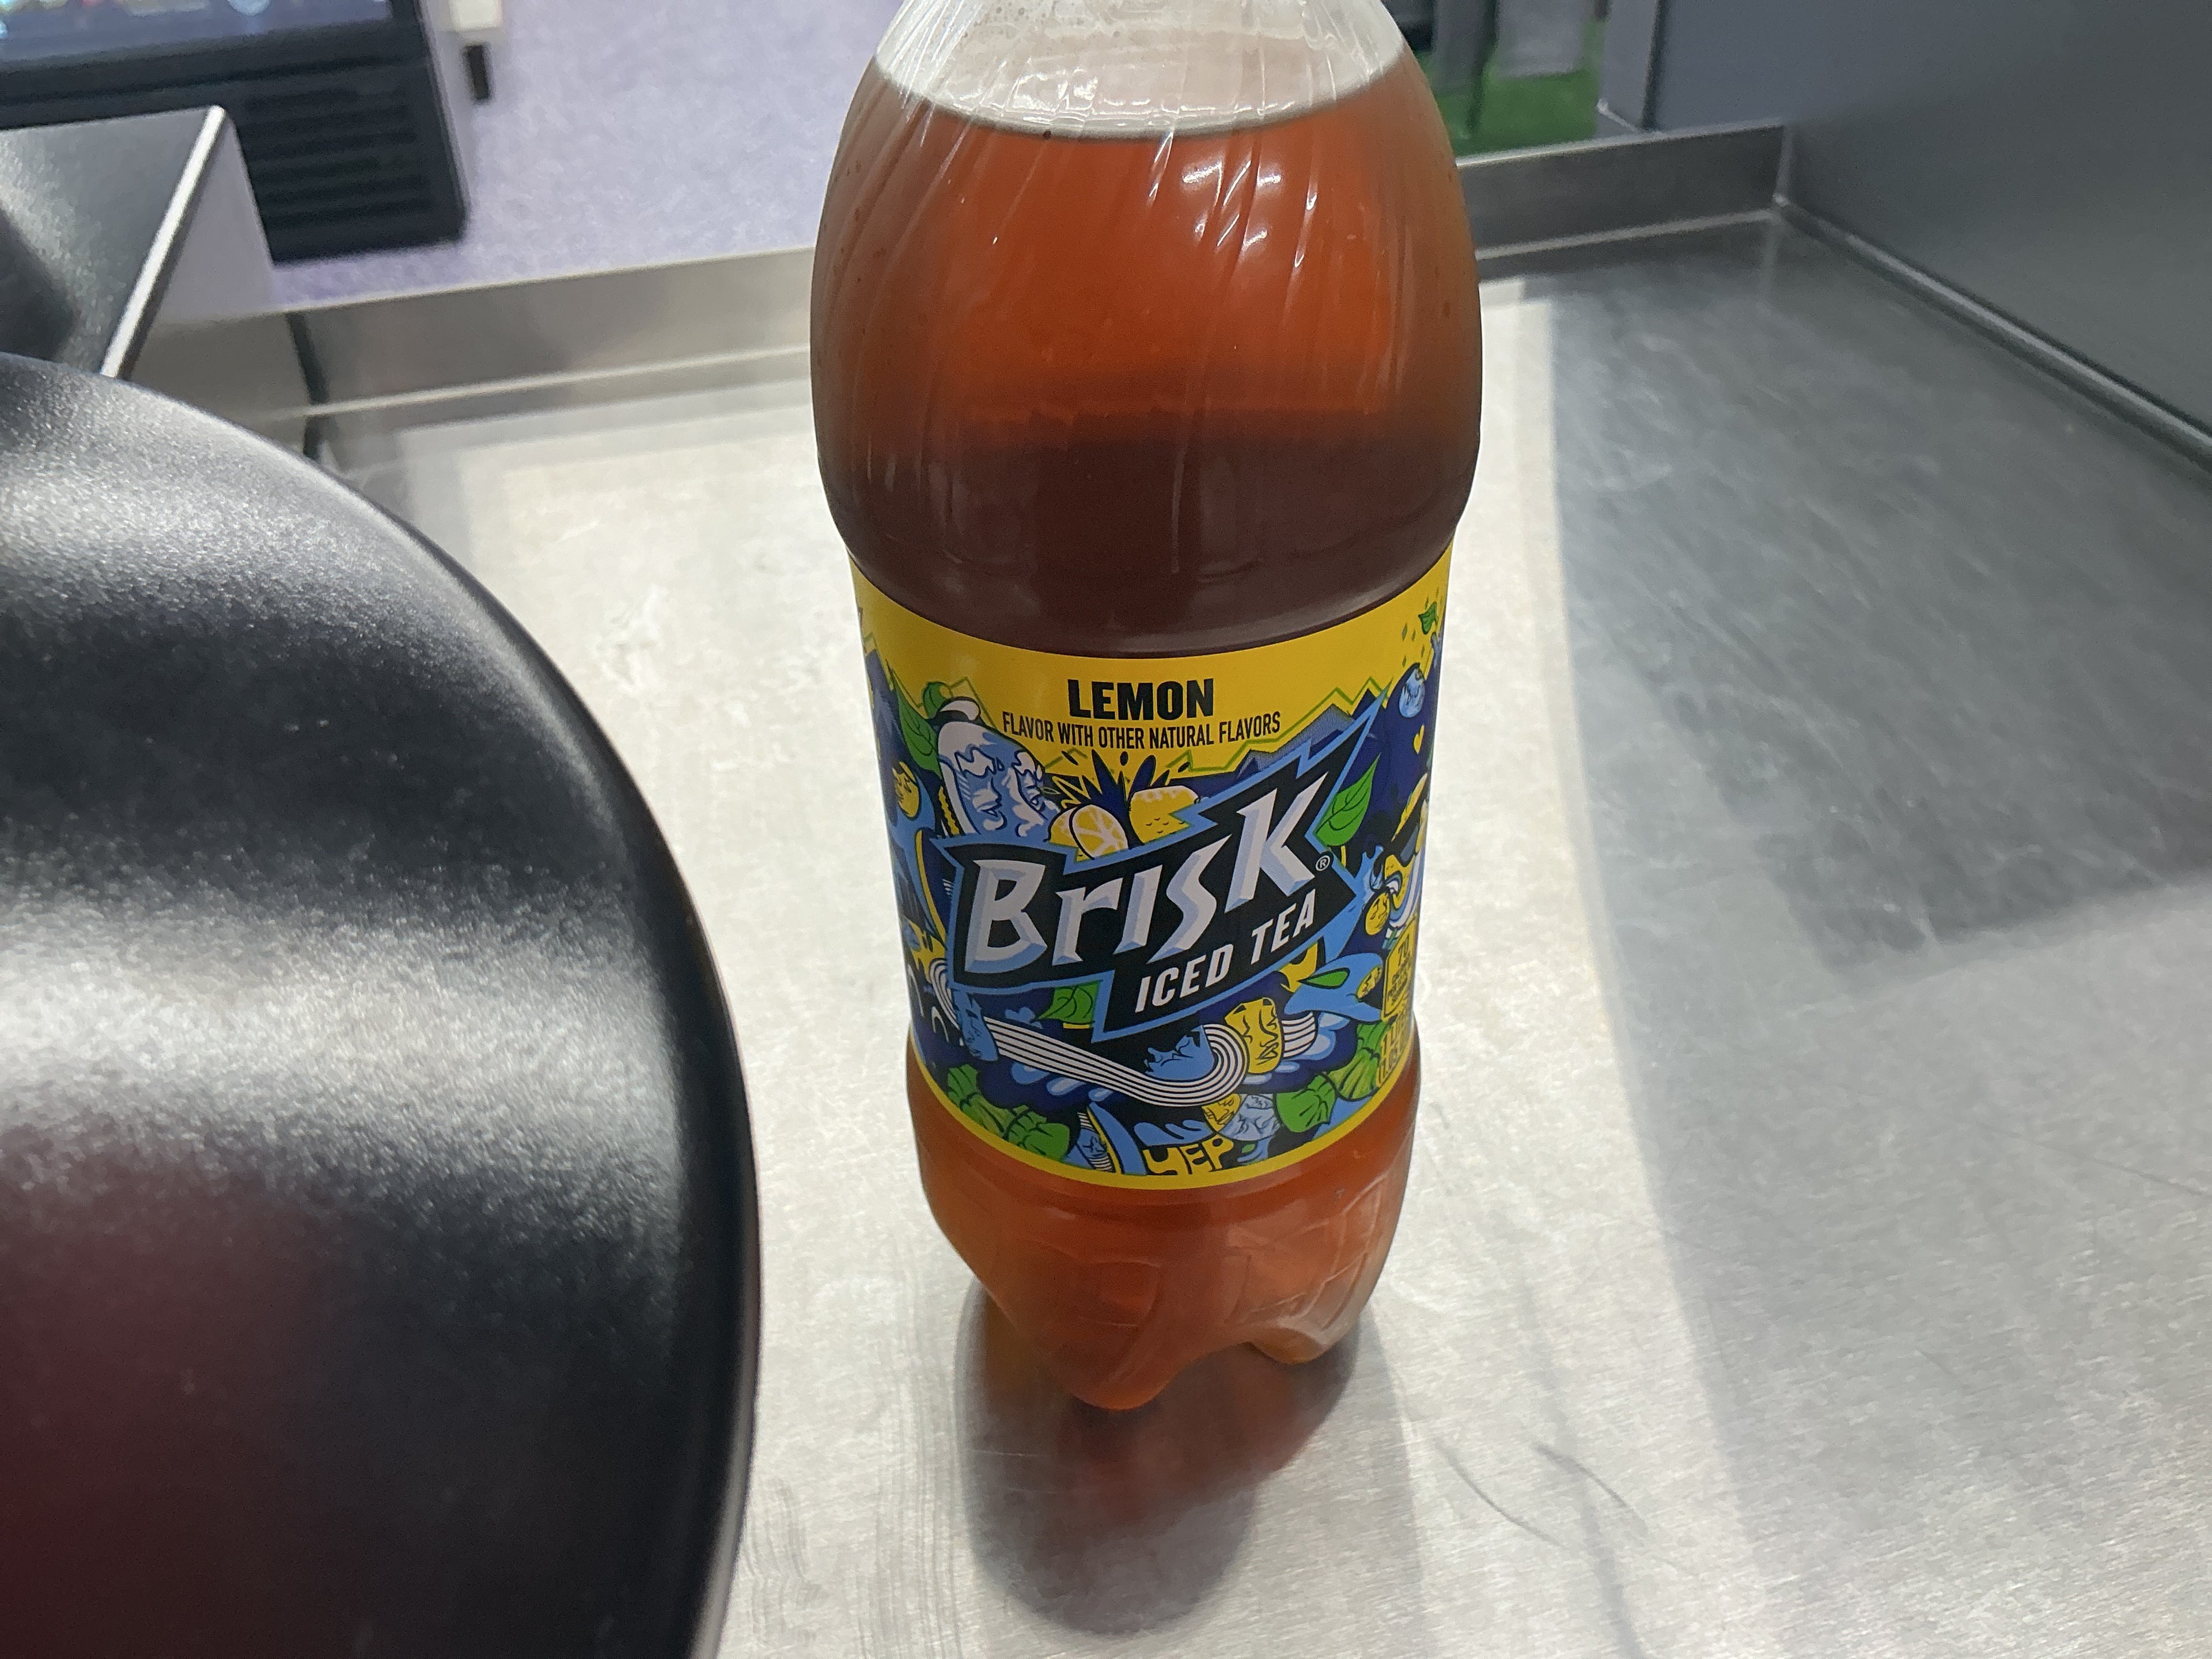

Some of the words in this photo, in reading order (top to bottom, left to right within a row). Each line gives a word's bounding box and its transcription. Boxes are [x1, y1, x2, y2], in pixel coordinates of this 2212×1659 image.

[1067, 677, 1214, 721] LEMON
[1002, 711, 1055, 743] FLAVOR
[1057, 721, 1094, 747] WITH
[1098, 726, 1145, 749] OTHER
[1149, 724, 1214, 749] NATURAL
[1218, 711, 1281, 743] FLAVORS
[1134, 943, 1234, 1013] ICED
[1250, 888, 1316, 965] TEA
[1142, 1133, 1234, 1176] YEP
